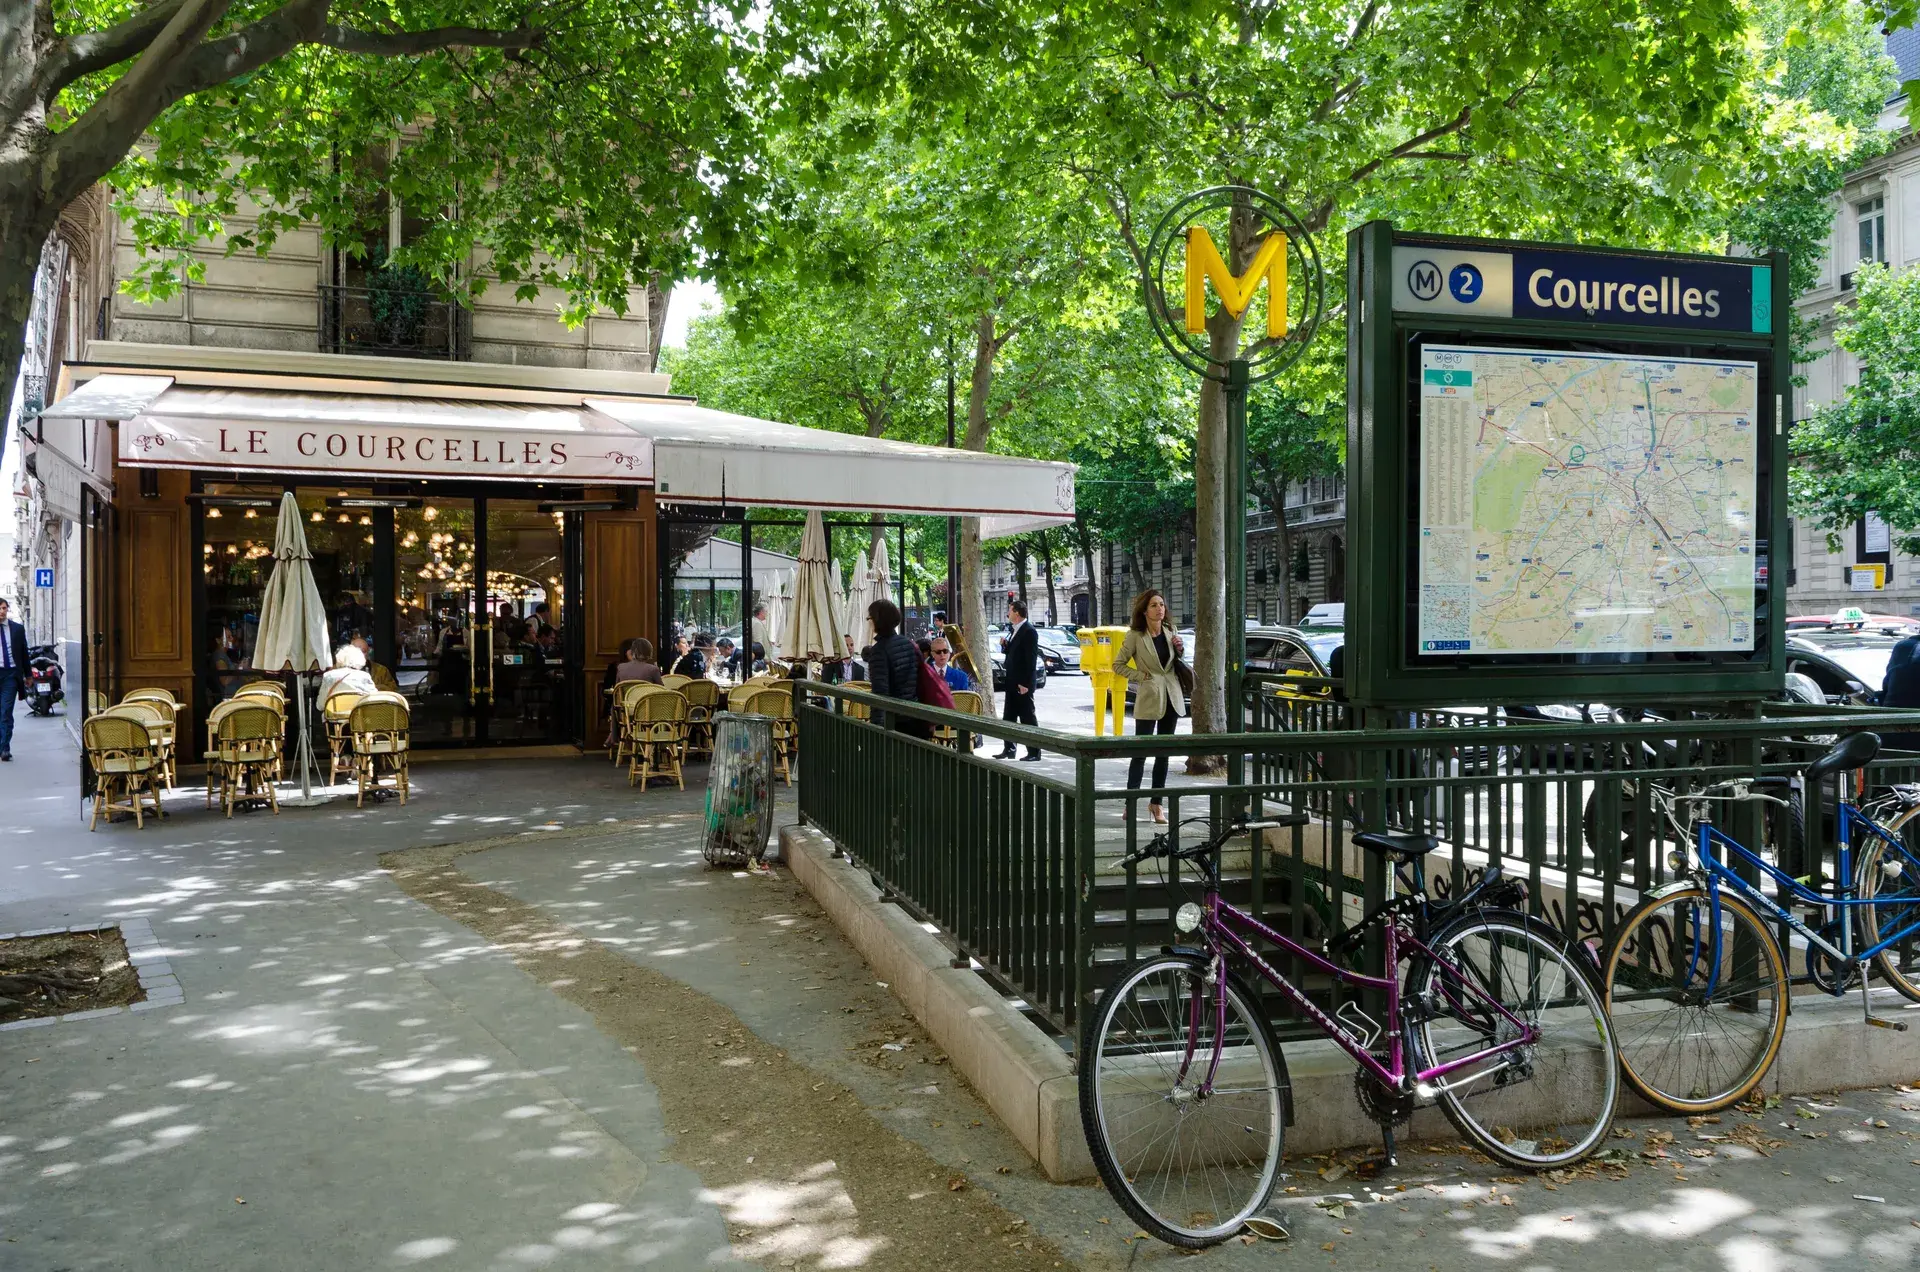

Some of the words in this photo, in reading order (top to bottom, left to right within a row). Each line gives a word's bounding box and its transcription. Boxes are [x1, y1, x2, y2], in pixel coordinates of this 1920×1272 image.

[1185, 226, 1287, 338] M
[1416, 269, 1435, 292] M
[1459, 271, 1473, 295] 2
[1528, 268, 1721, 318] Courcelles
[219, 429, 268, 454] LE
[297, 432, 568, 465] COURCELLES
[41, 572, 50, 585] H
